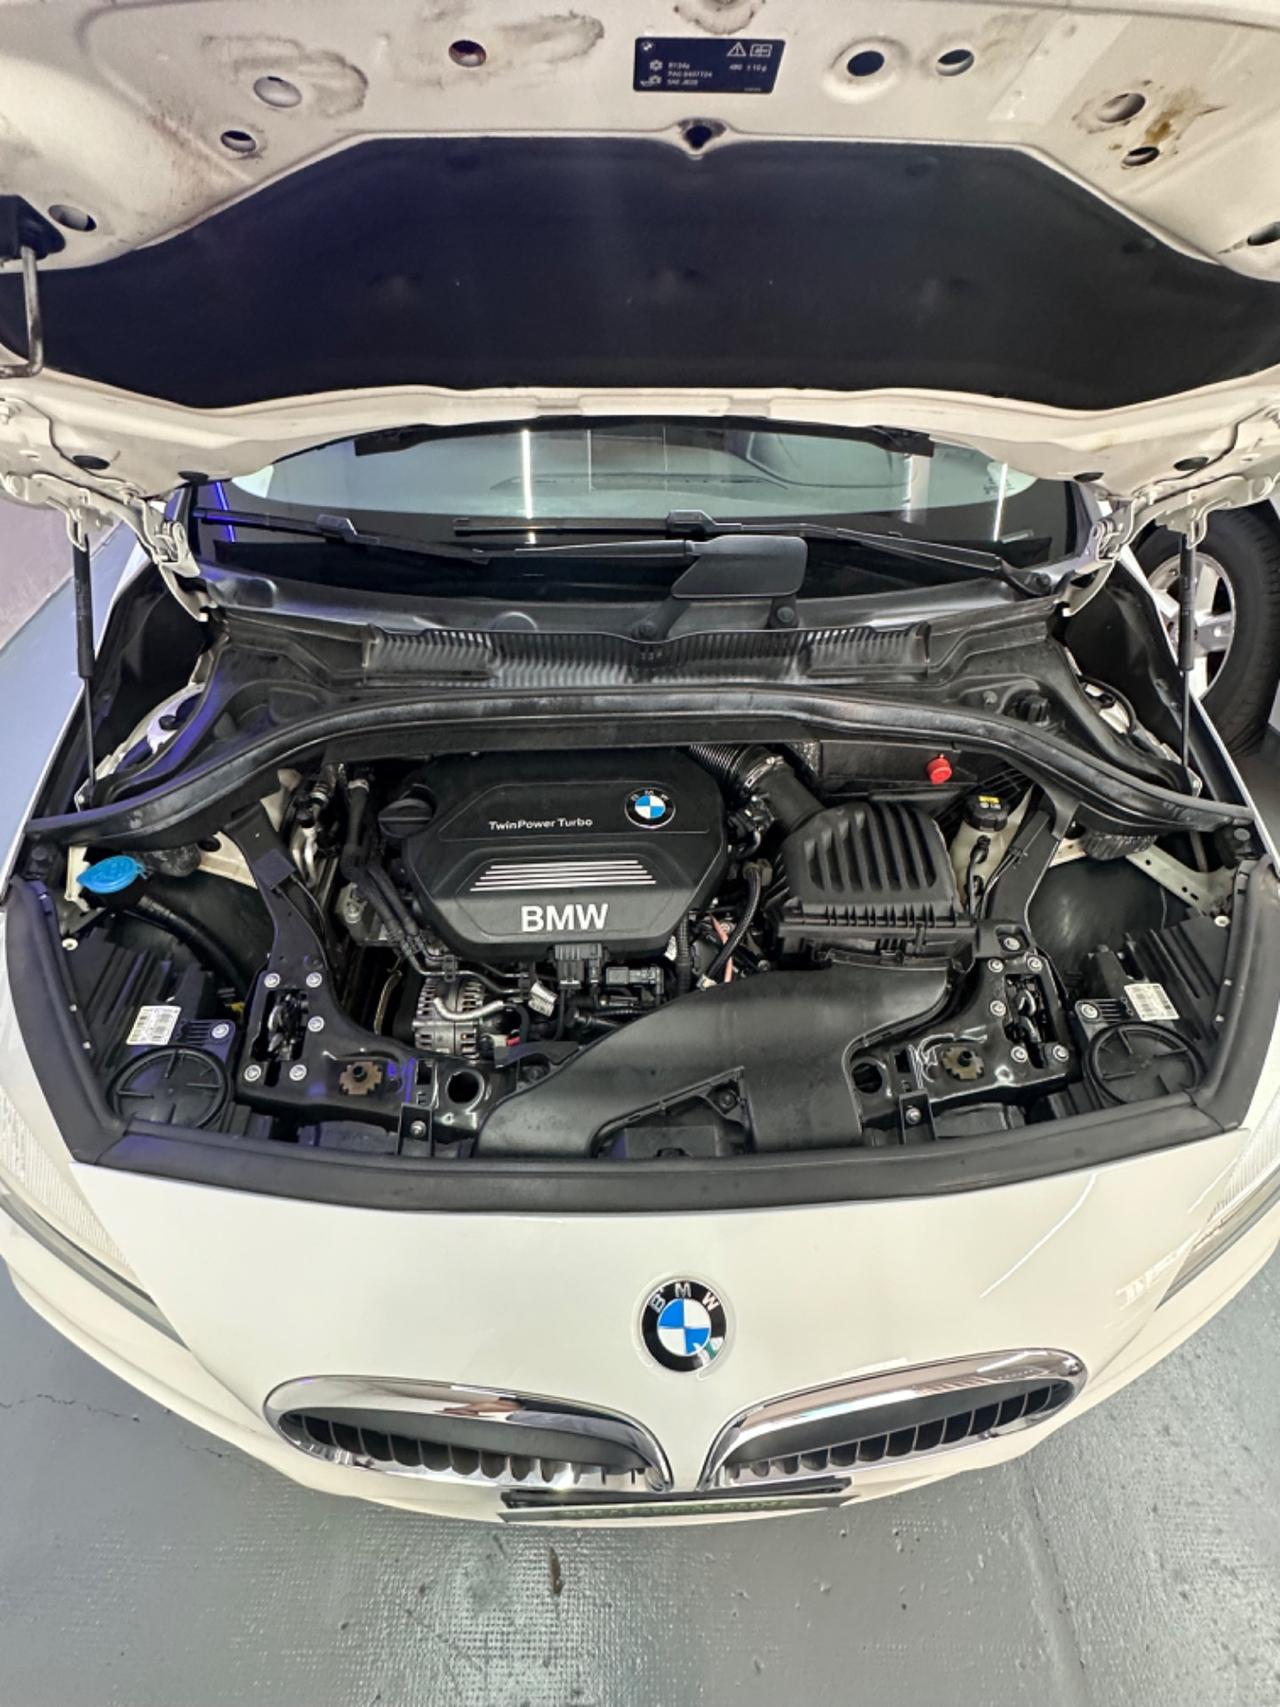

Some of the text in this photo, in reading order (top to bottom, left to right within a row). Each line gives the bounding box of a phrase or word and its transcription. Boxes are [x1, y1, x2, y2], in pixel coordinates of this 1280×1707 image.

[488, 817, 593, 831] TwinPower Turbo
[521, 903, 608, 932] BMW
[648, 1282, 720, 1313] BMW
